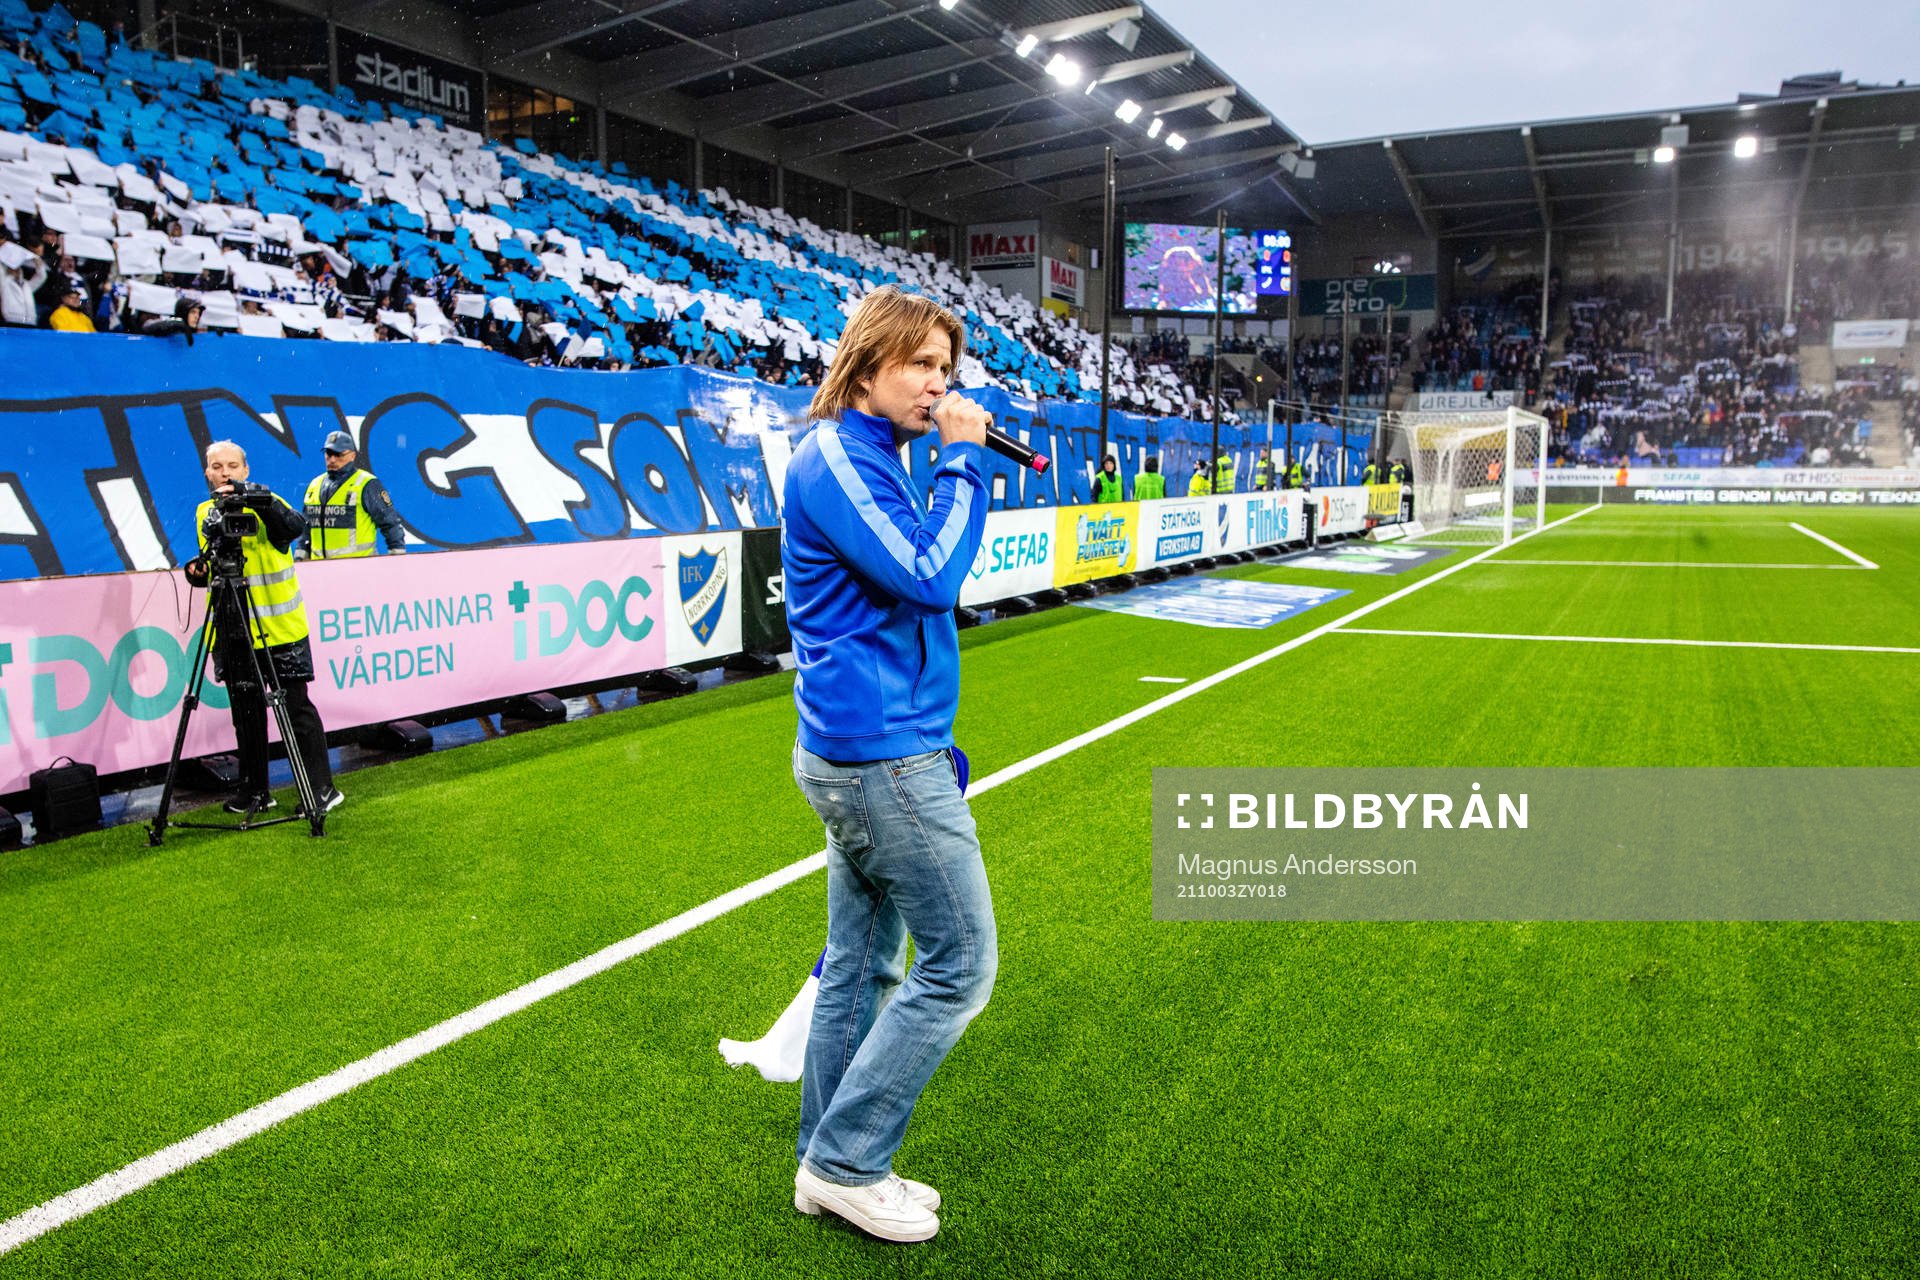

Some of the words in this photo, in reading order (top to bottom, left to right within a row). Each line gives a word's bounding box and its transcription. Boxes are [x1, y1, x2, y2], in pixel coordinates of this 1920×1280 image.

[355, 52, 470, 113] stadium
[1326, 278, 1369, 299] pre
[1437, 394, 1513, 409] REJLERS
[1773, 490, 1828, 503] NATUR
[1247, 498, 1289, 546] Flinks
[990, 532, 1049, 573] SEFAB
[683, 565, 703, 584] IFK
[319, 593, 493, 643] BEMANNAR
[329, 642, 455, 690] VÅRDEN
